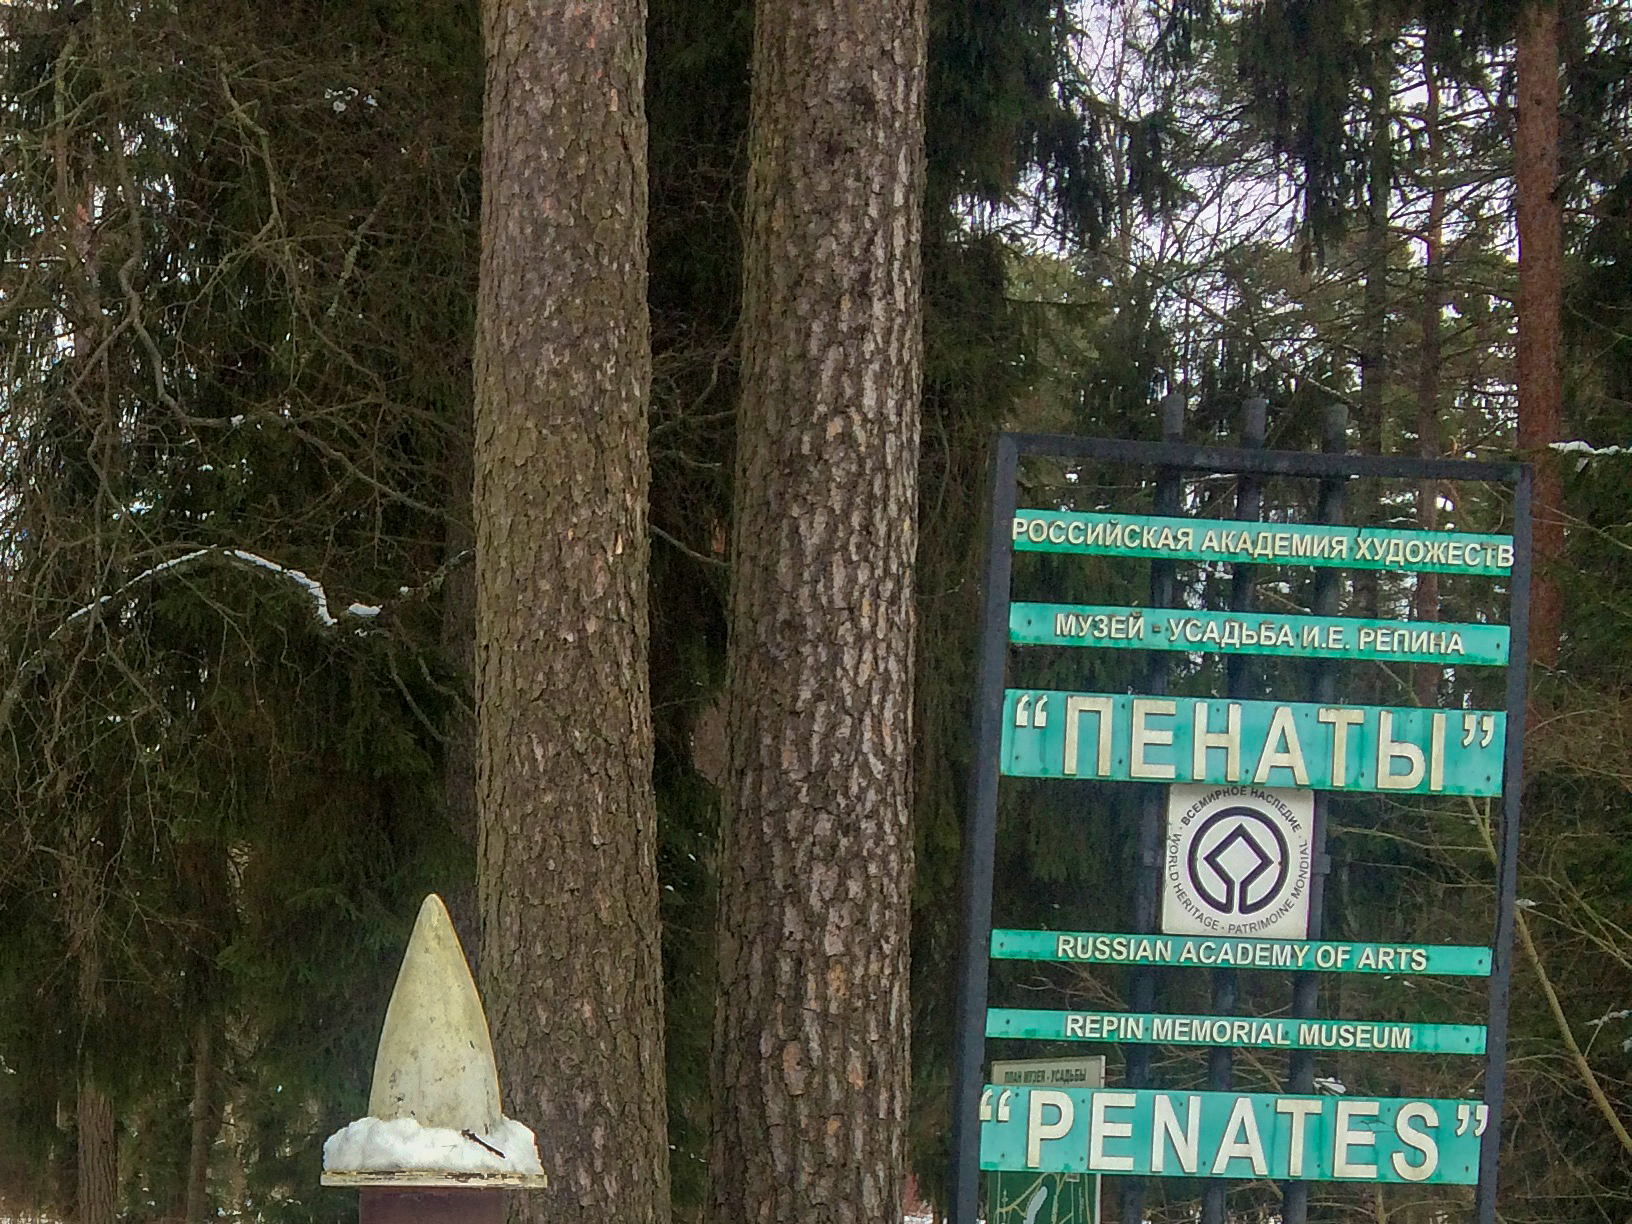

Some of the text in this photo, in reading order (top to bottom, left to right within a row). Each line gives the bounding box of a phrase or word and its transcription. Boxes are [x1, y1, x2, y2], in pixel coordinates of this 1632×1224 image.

[1012, 518, 1515, 567] РОССИЙСКАЯ АКАДЕМИЯ ХУДОЖЕСТВ
[1055, 612, 1145, 640] МУЗЕЙ
[1168, 617, 1295, 649] УСАДЬБА
[1302, 625, 1351, 650] И.Е.
[1359, 628, 1466, 656] РЕПИНА
[1180, 785, 1303, 833] ВСЕМИРНОЕ НАСЛЕДИЕ
[1168, 832, 1220, 932] WORLD HERITAGE
[1228, 839, 1310, 934] PATRIMOINE MONDIAL
[1057, 935, 1428, 971] RUSSIAN ACADEMY OF ARTS
[1066, 1014, 1411, 1049] REPIN MEMORIAL MUSEUM
